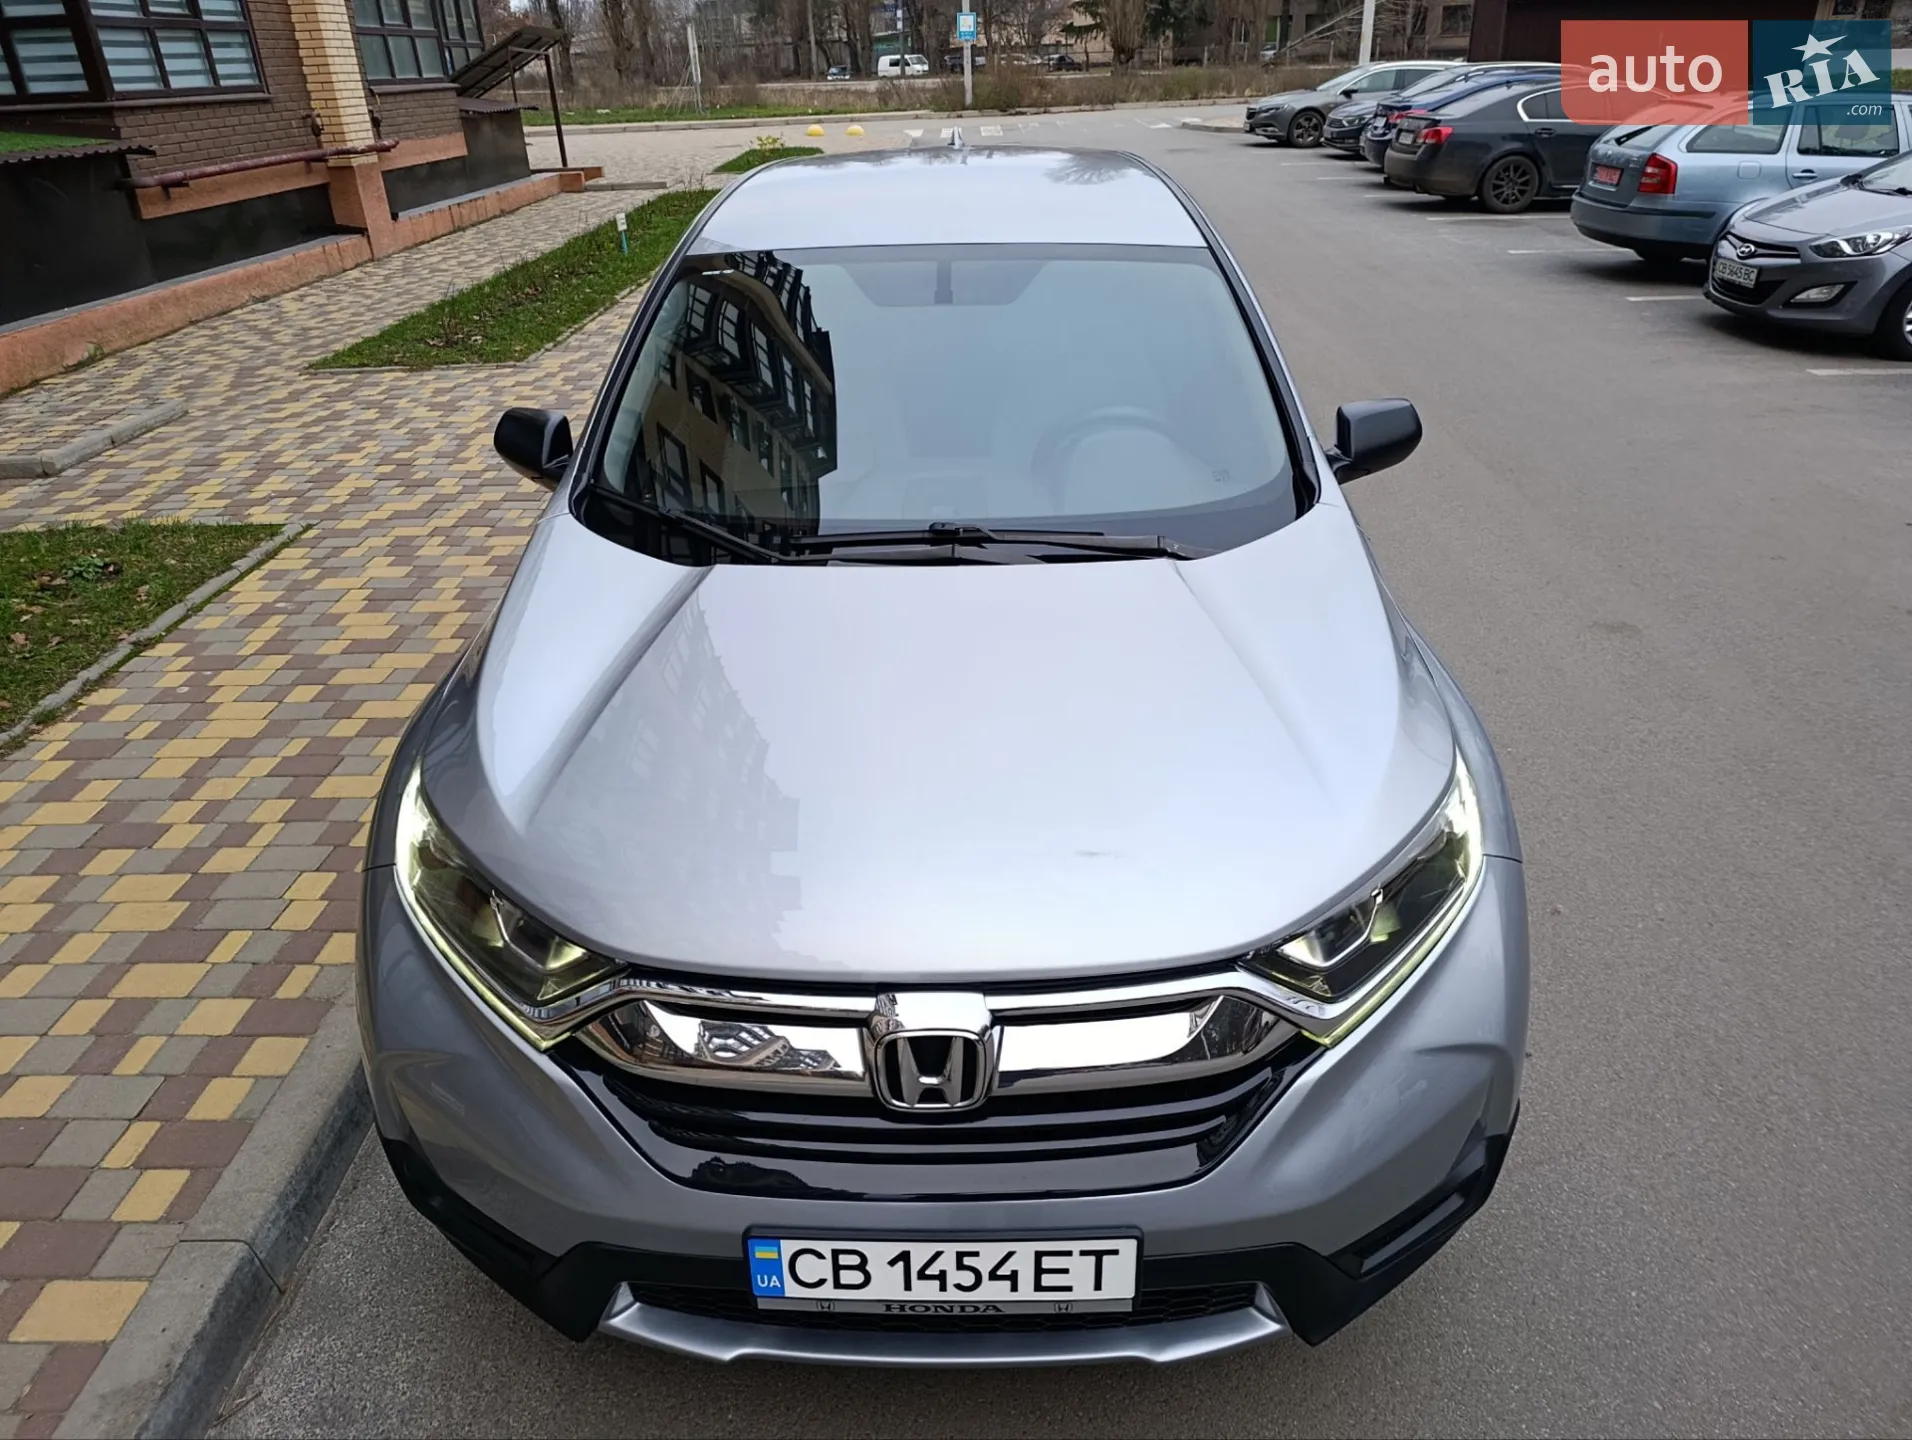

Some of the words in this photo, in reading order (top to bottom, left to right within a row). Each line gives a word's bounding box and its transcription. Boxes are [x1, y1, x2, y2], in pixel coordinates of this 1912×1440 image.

[788, 1247, 872, 1291] CB
[886, 1250, 1019, 1293] 1454
[1033, 1249, 1120, 1293] ET
[757, 1274, 781, 1288] UA
[883, 1304, 1006, 1314] HONDA
